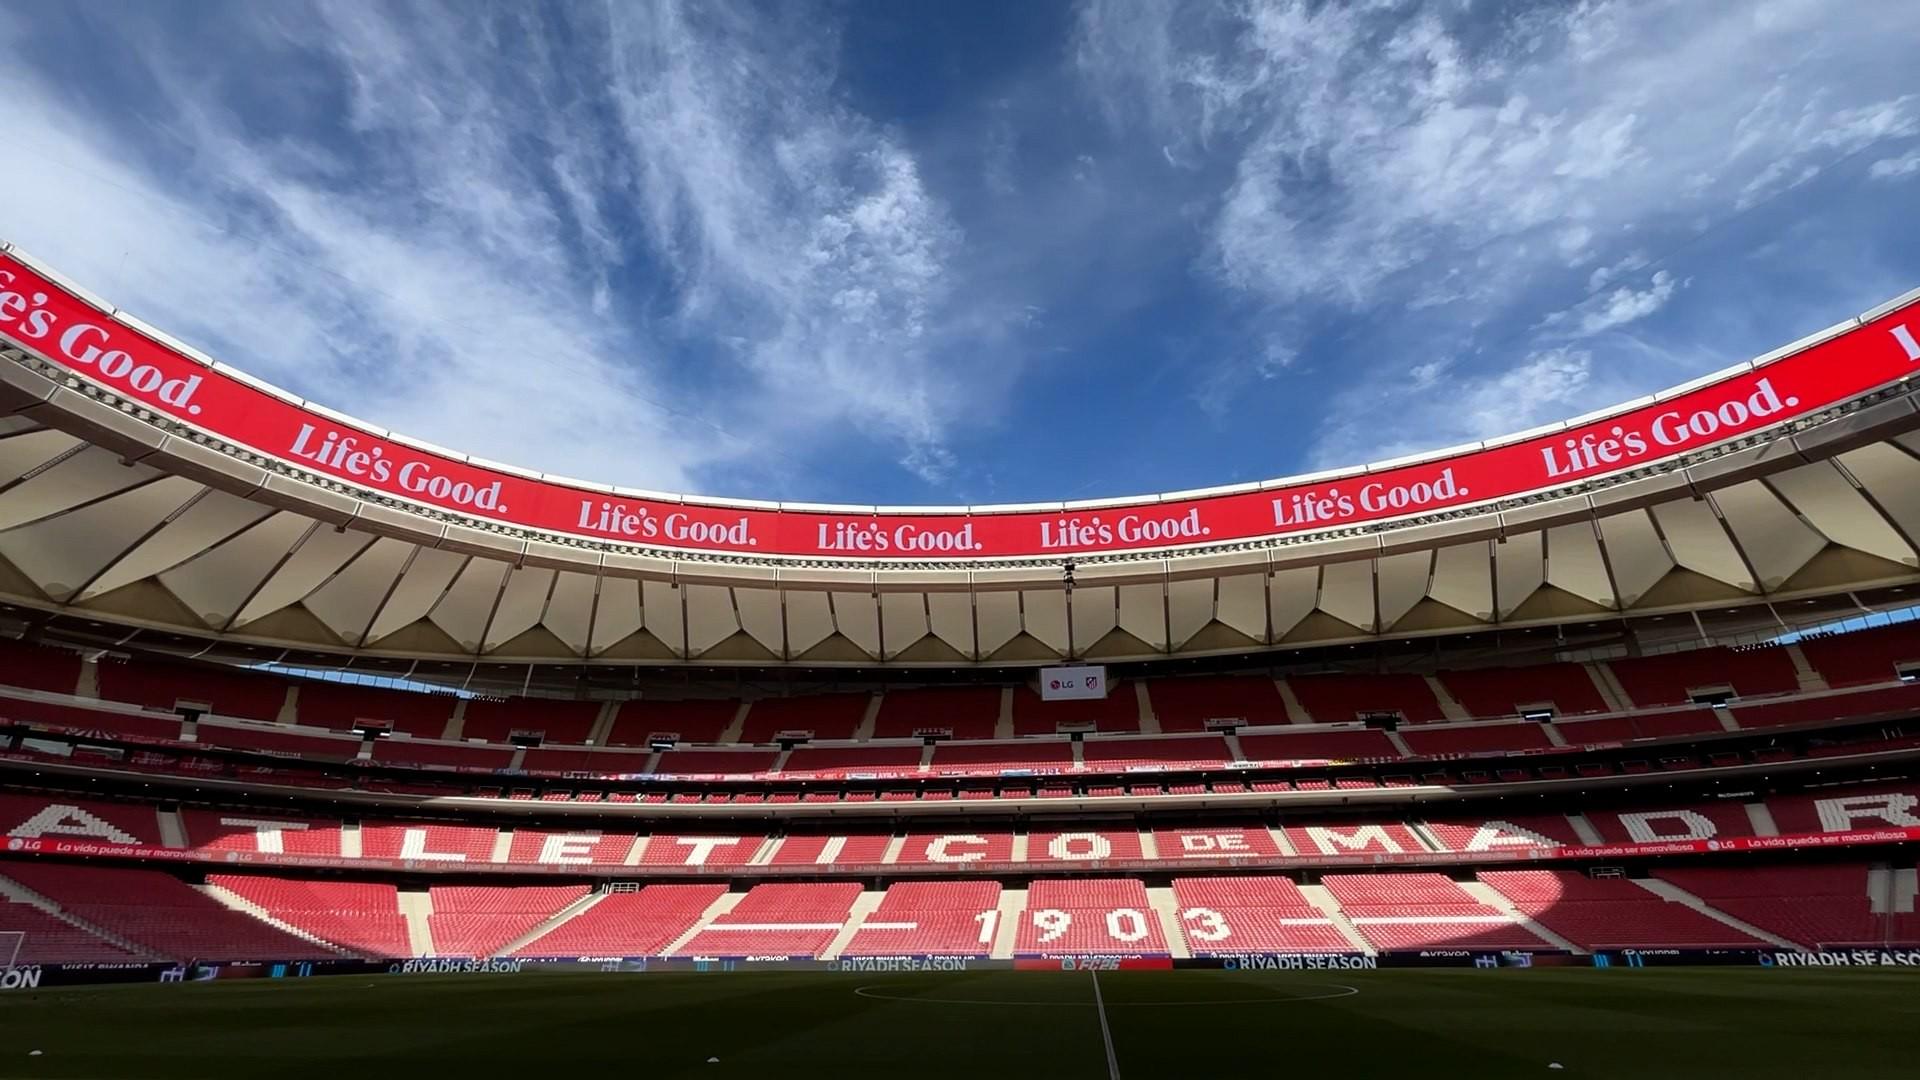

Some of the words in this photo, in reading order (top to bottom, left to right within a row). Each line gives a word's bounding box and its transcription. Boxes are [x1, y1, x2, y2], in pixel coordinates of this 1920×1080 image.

[0, 270, 57, 338] e's
[59, 324, 203, 415] Good.
[1540, 426, 1647, 478] Life's
[1651, 377, 1799, 447] Good.
[289, 423, 393, 482] Life's
[399, 461, 508, 513] Good.
[1272, 488, 1355, 527] Life's
[1359, 467, 1469, 512] Good.
[577, 500, 657, 538] Life's
[664, 513, 757, 546] Good.
[1040, 516, 1113, 548] Life's
[1117, 507, 1210, 542] Good.
[817, 523, 889, 551] Life's
[894, 523, 982, 551] Good.
[1062, 681, 1074, 689] LG
[24, 841, 42, 850] LG
[56, 842, 71, 851] La
[73, 844, 98, 853] vida
[98, 846, 133, 856] puede
[135, 848, 153, 857] ser
[1181, 834, 1251, 852] DE
[1720, 841, 1735, 849] LG
[1747, 839, 1761, 848] La
[1763, 838, 1785, 847] vida
[1787, 836, 1821, 847] puede
[1841, 831, 1908, 842] maravillosa
[1575, 848, 1594, 856] vida
[1595, 846, 1623, 856] puede
[402, 961, 461, 973] RIYADH
[463, 960, 522, 972] SEASON
[842, 960, 899, 971] RIYADH
[902, 960, 966, 971] SEASON
[1240, 957, 1302, 970] RIYADH
[1306, 956, 1377, 970] SEASON
[1775, 952, 1850, 966] RIYADH
[0, 970, 42, 989] ON
